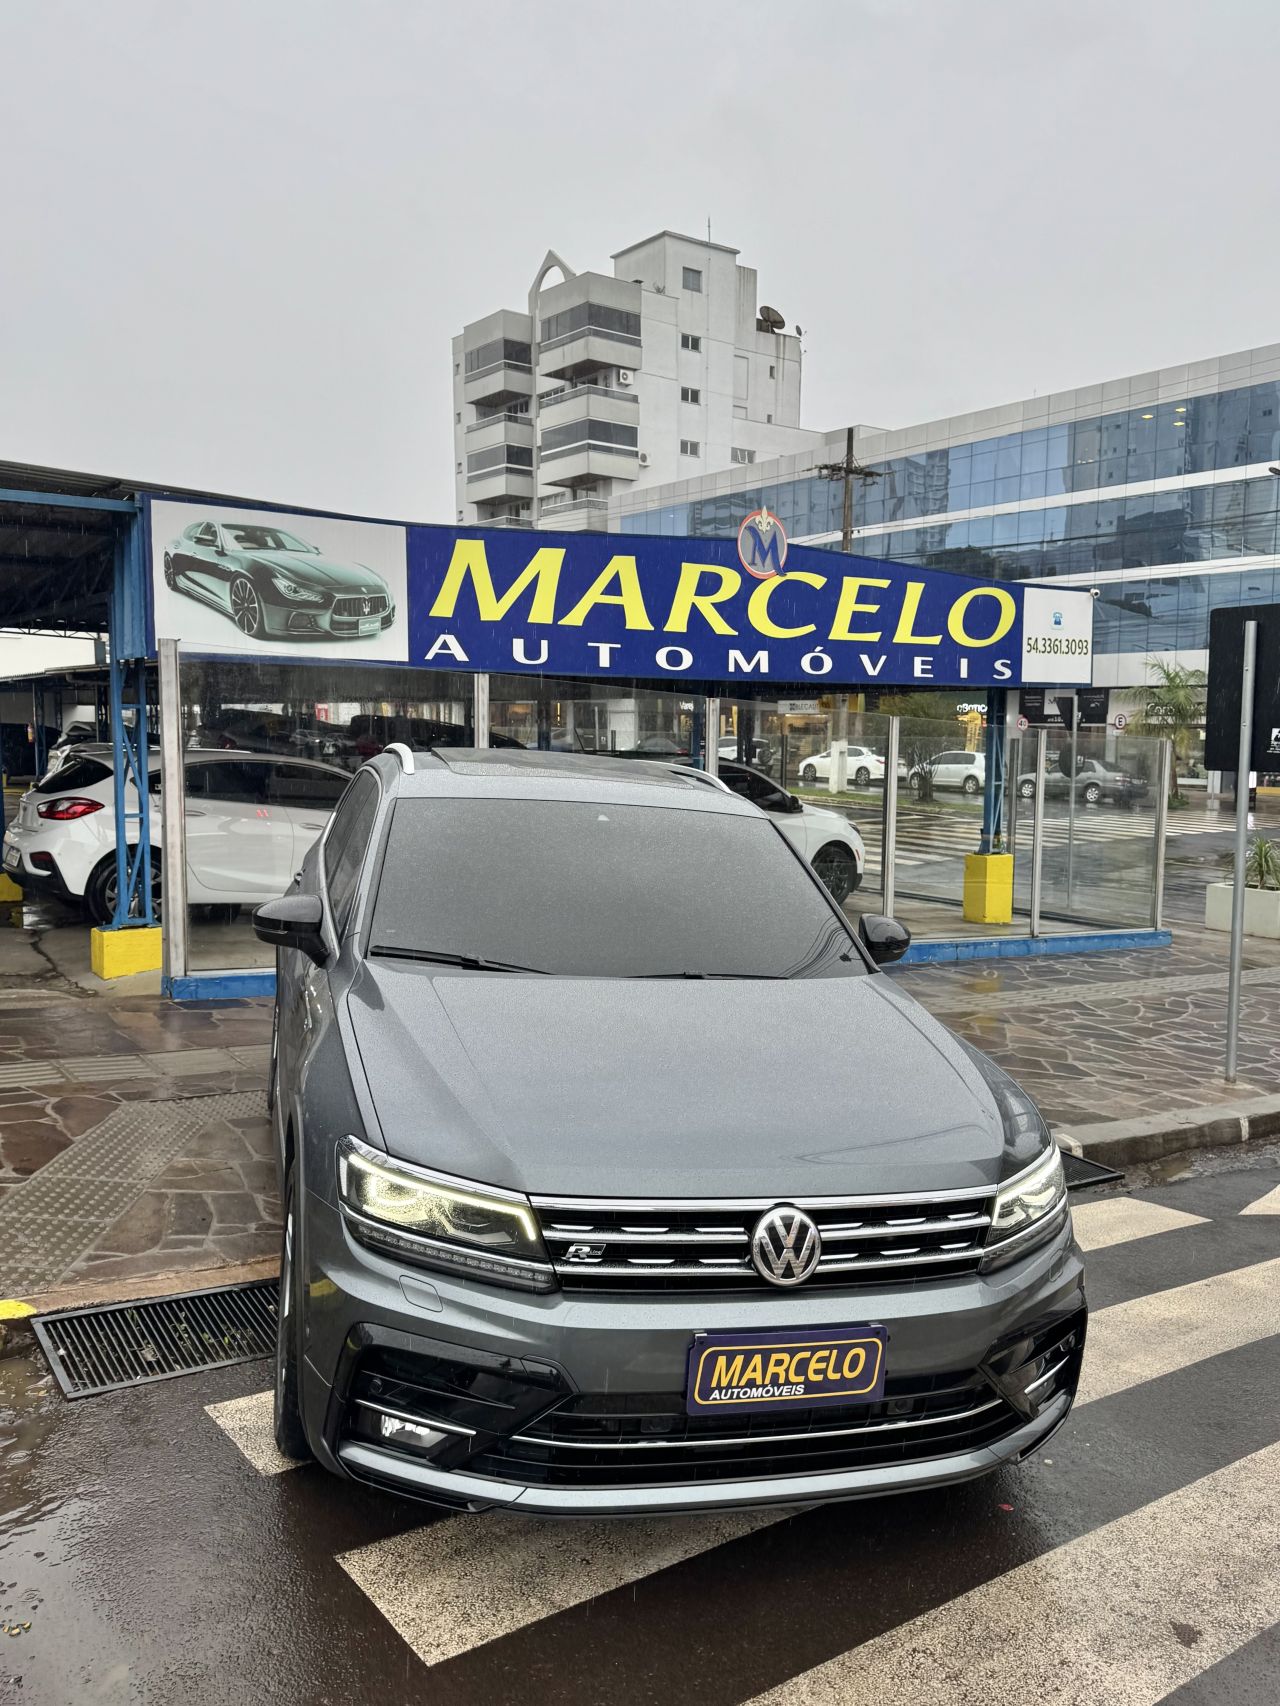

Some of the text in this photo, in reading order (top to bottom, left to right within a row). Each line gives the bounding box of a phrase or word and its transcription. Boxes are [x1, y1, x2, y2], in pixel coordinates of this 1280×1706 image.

[430, 538, 1016, 647] MARCELO
[424, 634, 1013, 681] AUTOMÓVEIS
[1026, 636, 1089, 656] 54.3361.3093
[710, 1347, 866, 1388] MARCELO
[709, 1384, 805, 1401] AUTOMÓVEIS
